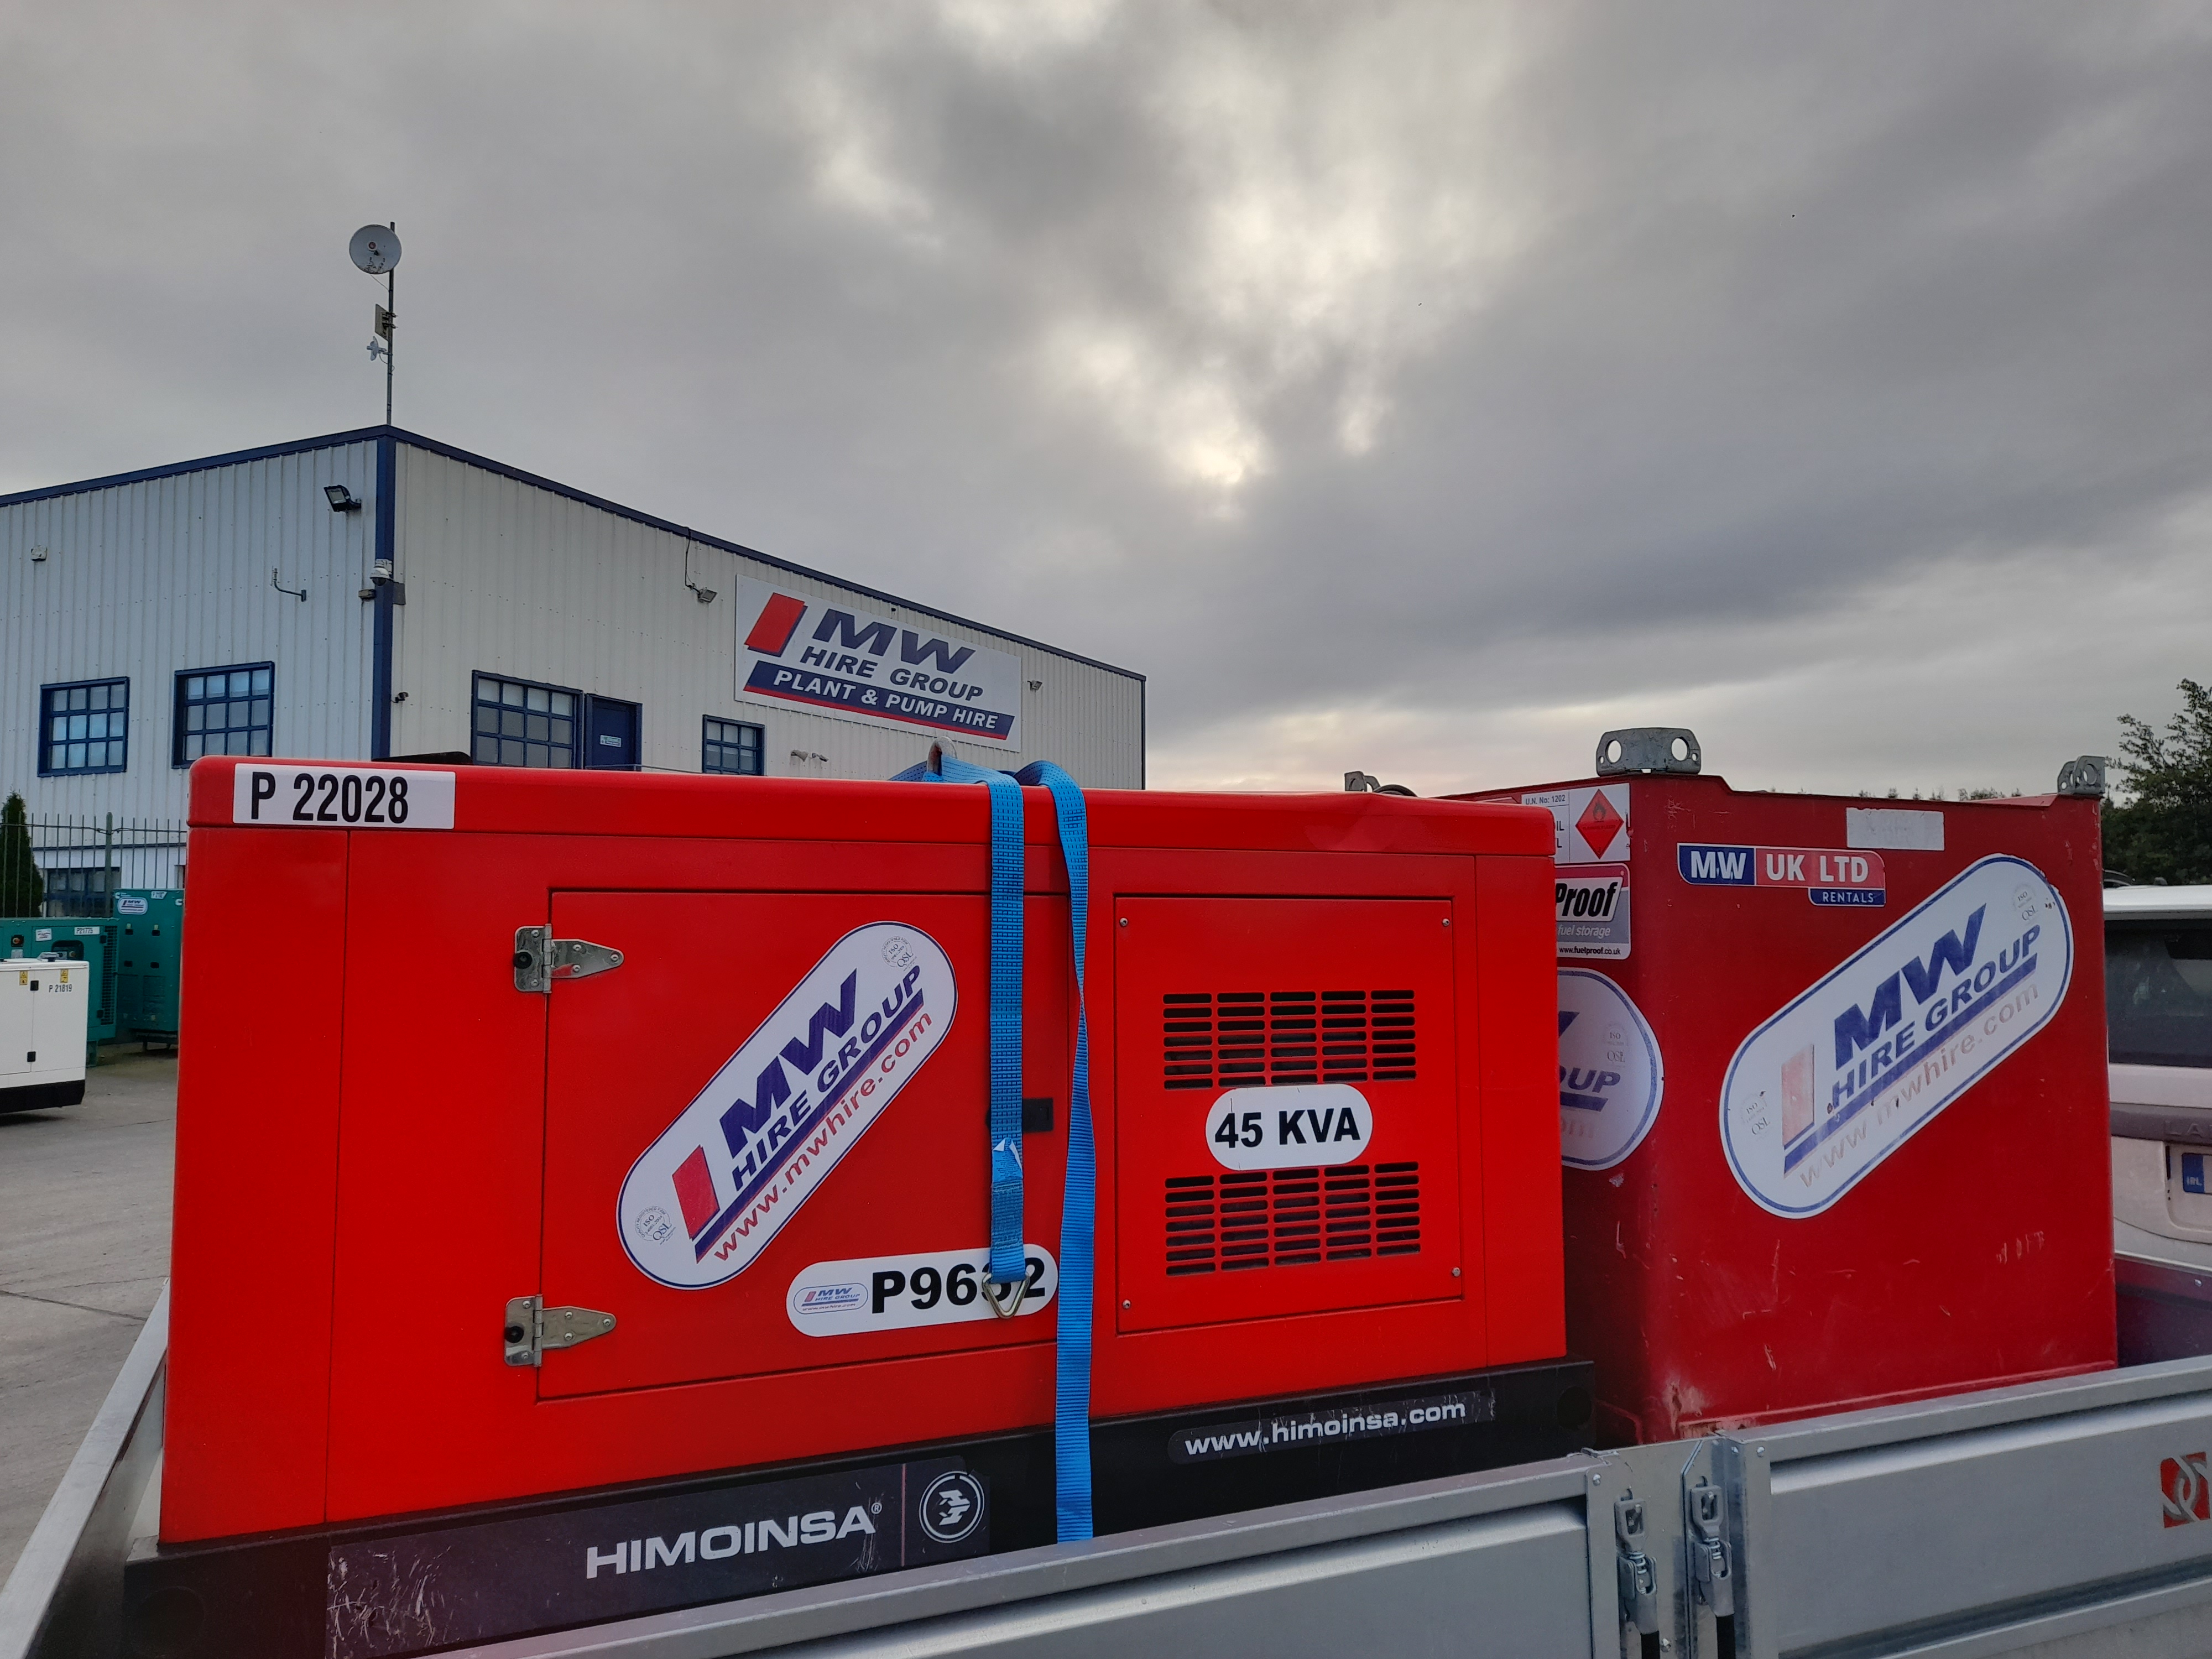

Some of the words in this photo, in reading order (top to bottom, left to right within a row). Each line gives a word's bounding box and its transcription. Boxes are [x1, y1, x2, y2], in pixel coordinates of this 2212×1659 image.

[812, 608, 975, 674] MW
[800, 646, 878, 679] HIRE
[890, 668, 983, 701] GROUP
[774, 670, 857, 700] PLANT
[861, 688, 878, 705] &
[885, 693, 947, 718] PUMP
[952, 708, 998, 729] HIRE
[251, 771, 276, 820] P
[293, 773, 408, 825] 22028
[1690, 850, 1746, 880] MW
[1766, 853, 1806, 882] UK
[1819, 855, 1869, 883] LTD
[1822, 891, 1875, 904] RENTALS
[889, 944, 899, 954] ISO
[1558, 924, 1575, 936] fuel
[1577, 925, 1611, 939] storage
[1559, 946, 1621, 956] www.fuelproof.co.uk
[897, 952, 914, 967] QSL
[55, 984, 72, 993] 21819
[1834, 902, 1987, 1071] MW
[1832, 1021, 1915, 1109] HIRE
[1925, 924, 2040, 1032] GROUP
[719, 968, 857, 1159] MW
[732, 1089, 811, 1192] HIRE
[817, 965, 921, 1094] GROUP
[714, 1012, 932, 1261] www.mwhire.com
[1214, 1112, 1263, 1148] 45
[1279, 1107, 1361, 1145] KVA
[643, 1215, 654, 1227] ISO
[653, 1223, 672, 1240] QSL
[818, 1287, 853, 1297] MW
[1185, 1401, 1467, 1455] www.himoinsa.com
